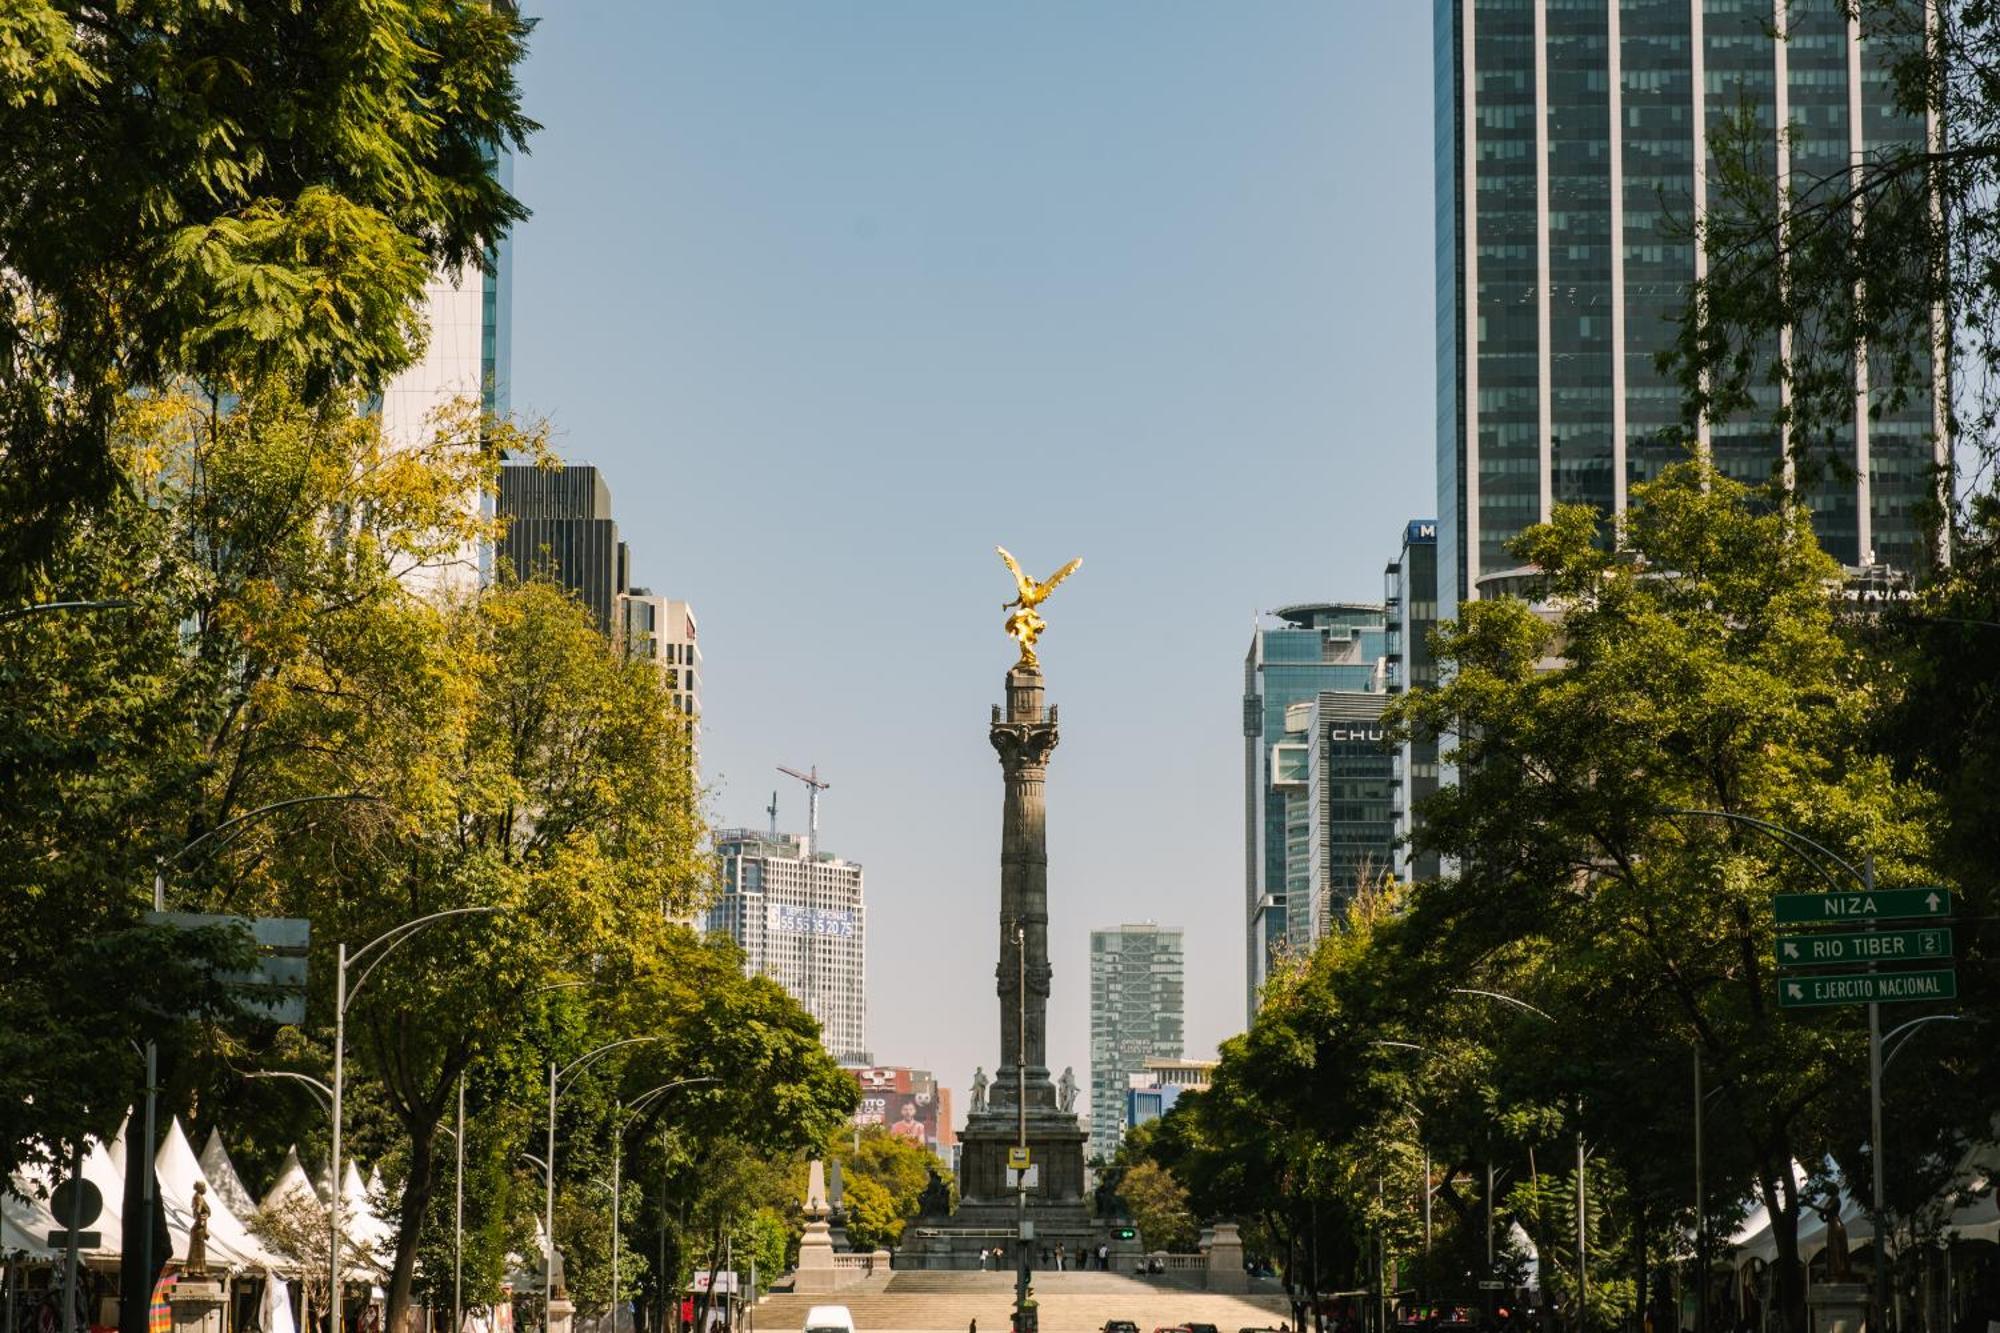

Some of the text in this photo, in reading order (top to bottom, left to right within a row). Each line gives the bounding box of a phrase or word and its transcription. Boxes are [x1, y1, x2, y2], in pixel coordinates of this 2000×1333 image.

[1332, 729, 1390, 741] CHU
[1824, 897, 1878, 915] NIZA
[781, 916, 794, 929] 55
[796, 917, 810, 931] 55
[826, 920, 839, 933] 20
[840, 922, 853, 936] 75
[1813, 937, 1935, 957] RIO TIBER 2
[1815, 977, 1941, 999] EJERCITO NACIONAL
